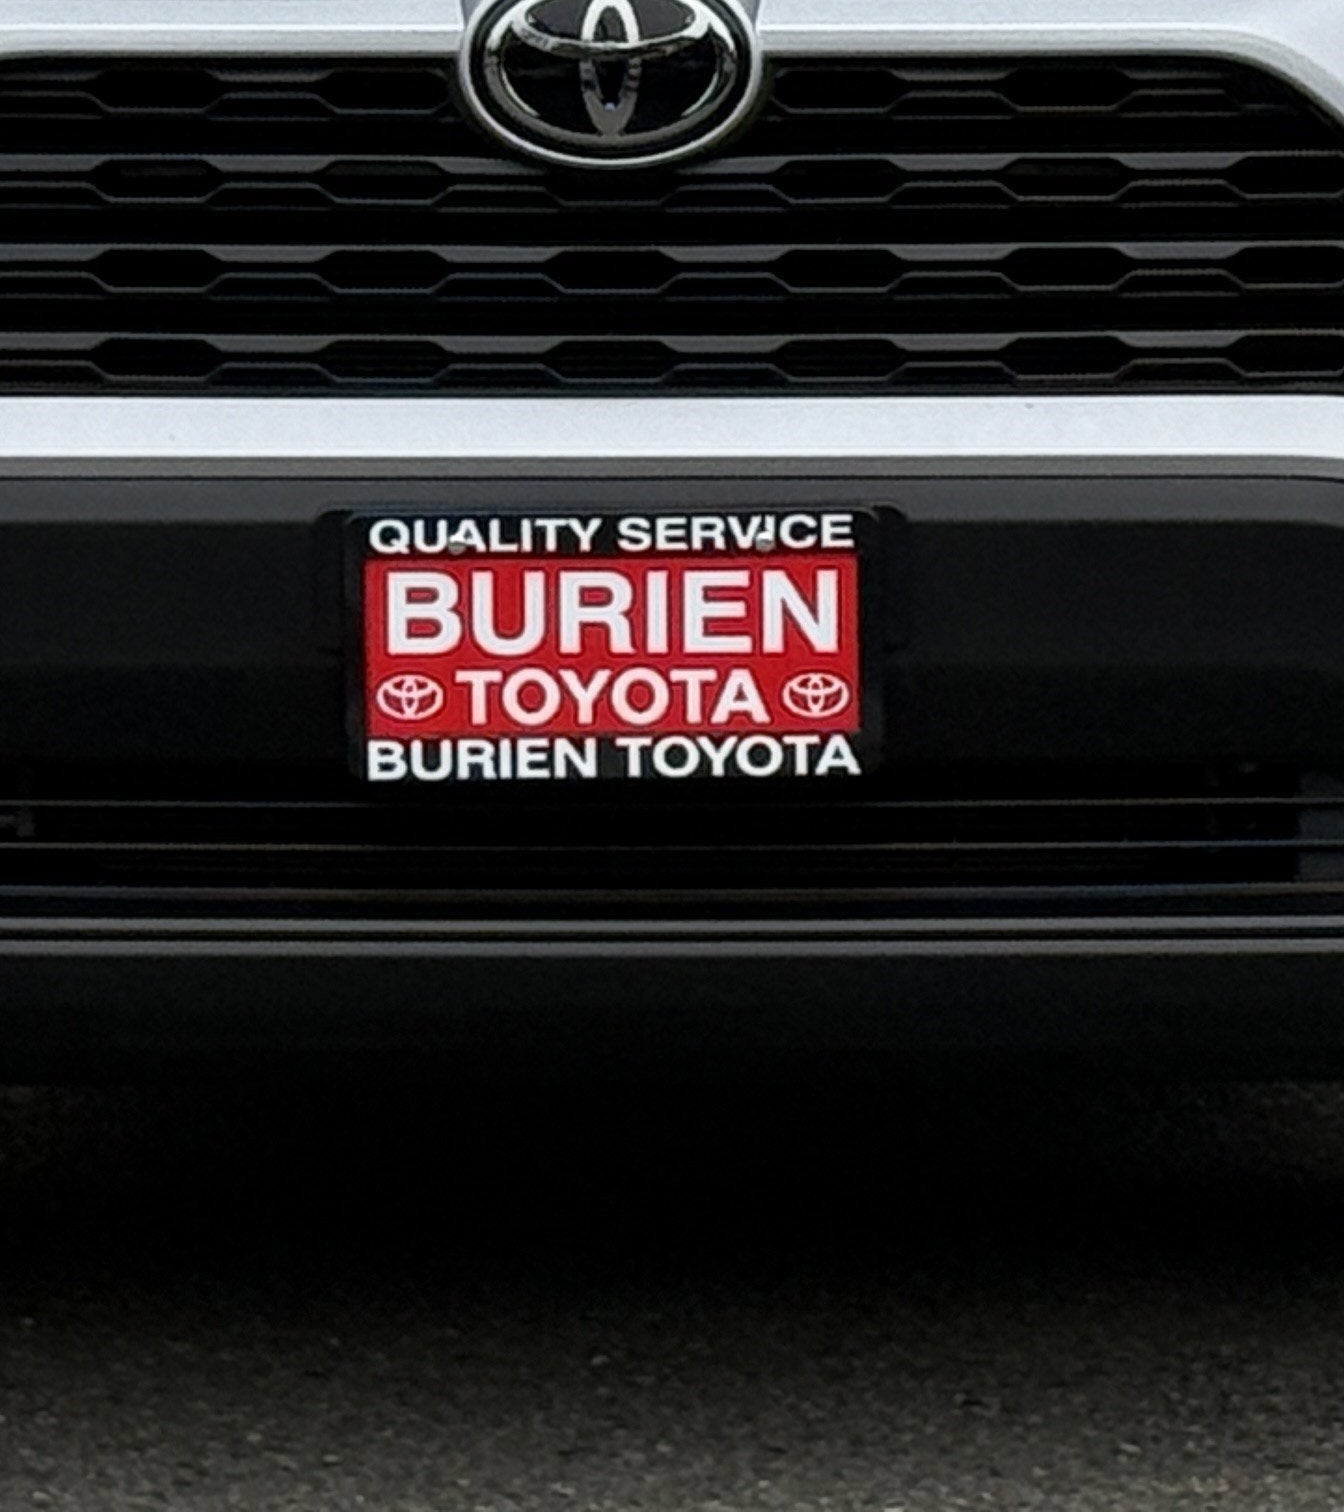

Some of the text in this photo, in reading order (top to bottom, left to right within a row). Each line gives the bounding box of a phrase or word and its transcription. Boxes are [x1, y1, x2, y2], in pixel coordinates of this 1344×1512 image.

[369, 514, 854, 554] QUALITY SERVICE
[387, 569, 839, 656] BURIEN
[456, 667, 771, 726] TOYOTA
[367, 734, 861, 781] BURIEN TOYOTA
